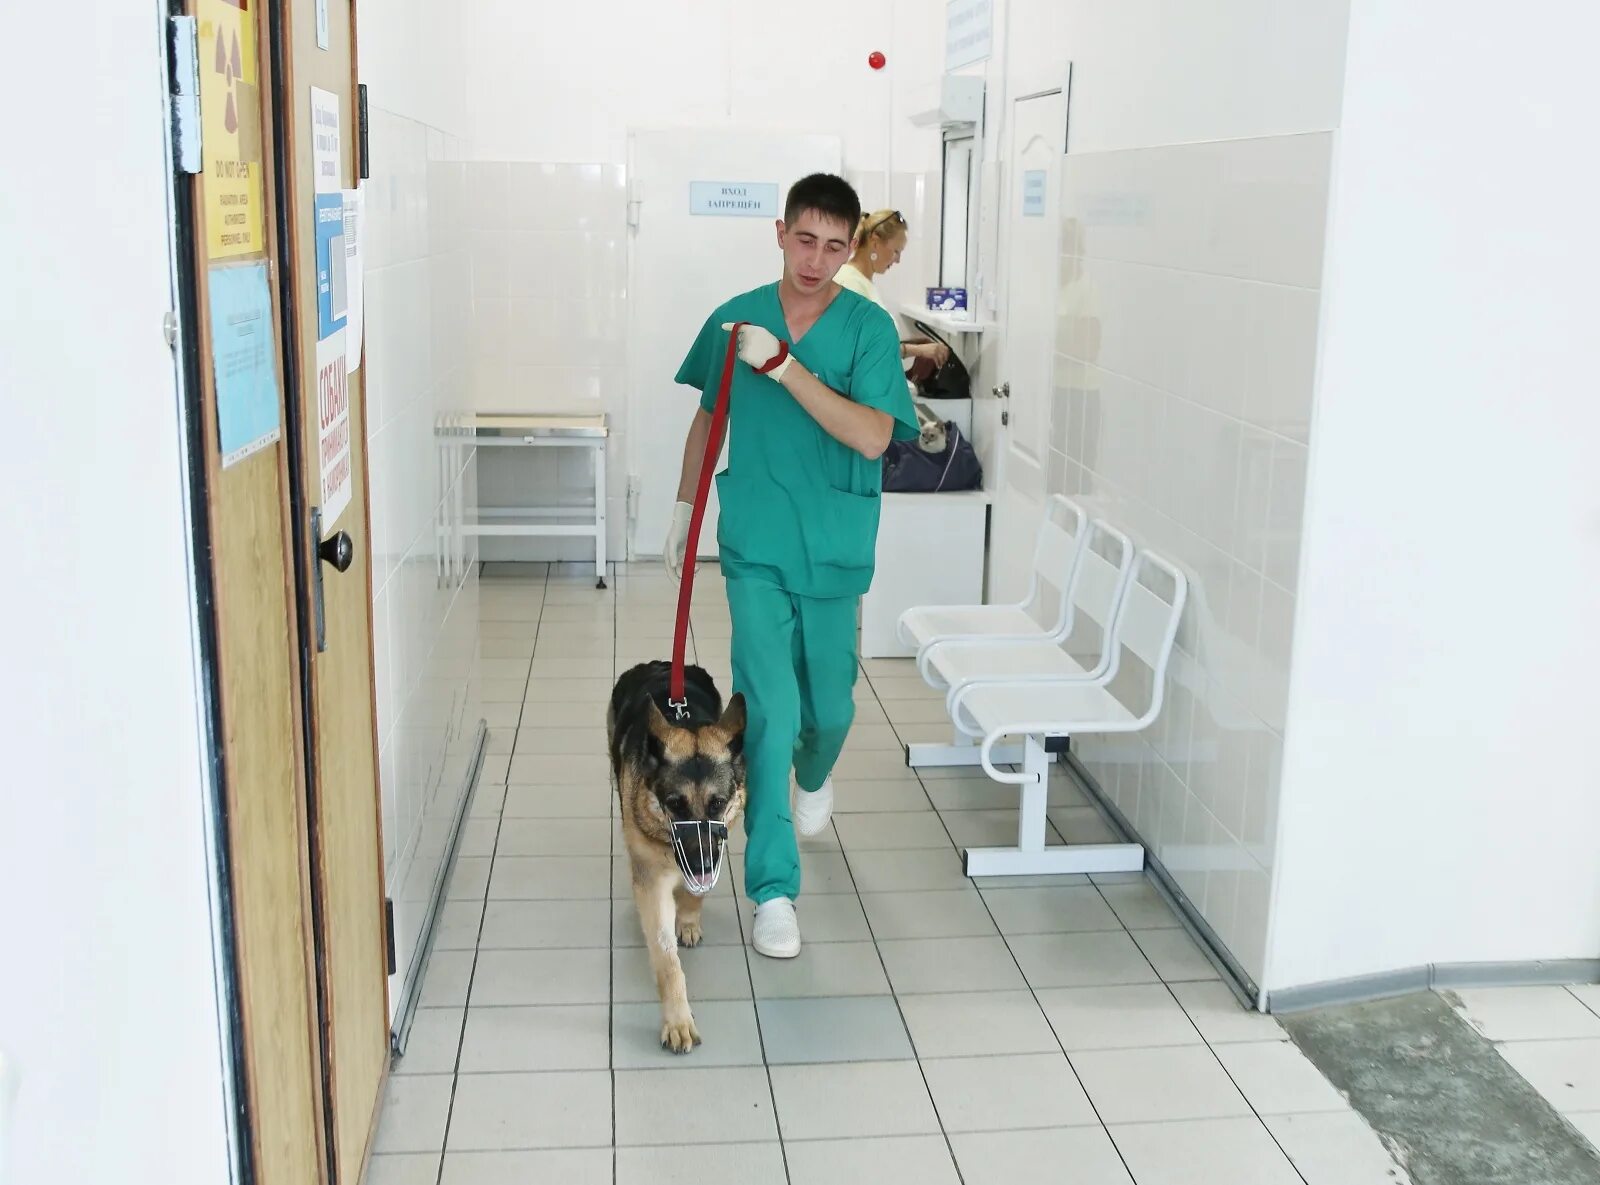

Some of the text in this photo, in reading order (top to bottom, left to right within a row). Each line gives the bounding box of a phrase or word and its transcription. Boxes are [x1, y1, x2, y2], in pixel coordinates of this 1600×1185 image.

[215, 160, 224, 178] DO
[721, 187, 747, 196] ВХОД
[319, 353, 348, 431] СОБАКИ
